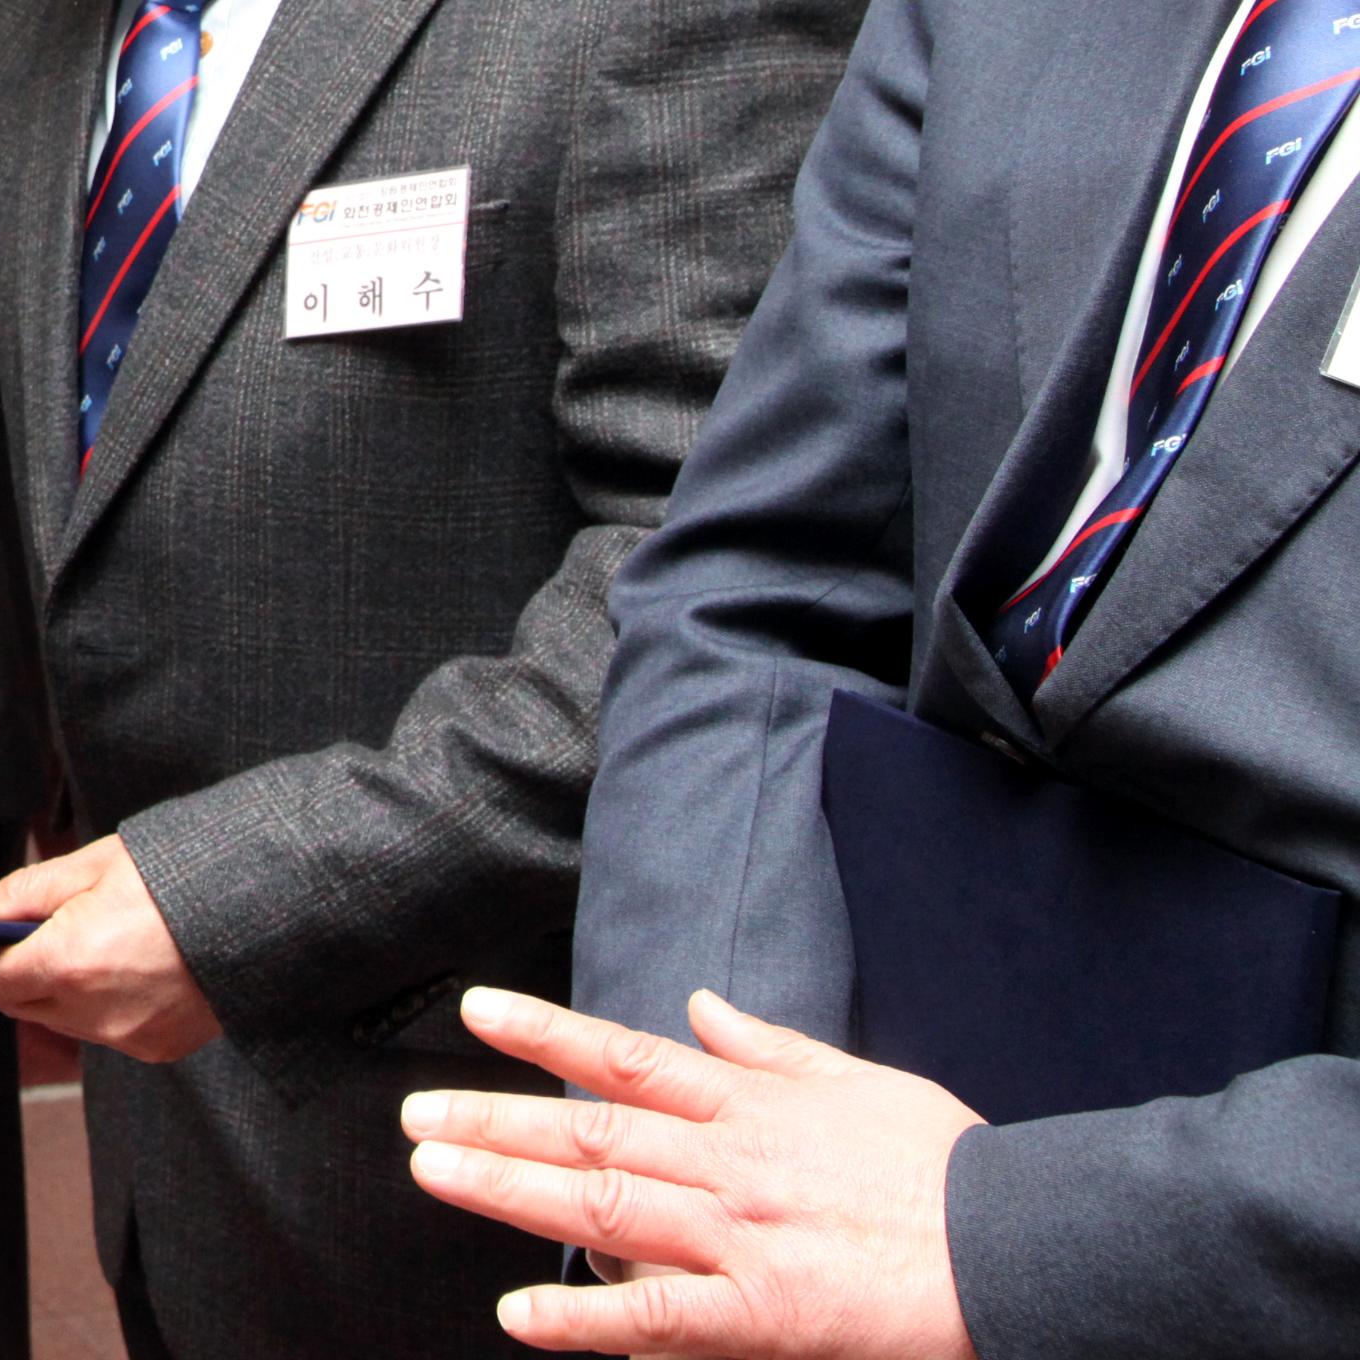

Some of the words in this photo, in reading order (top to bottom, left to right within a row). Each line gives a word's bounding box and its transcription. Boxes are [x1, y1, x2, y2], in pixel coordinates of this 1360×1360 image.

[1333, 13, 1360, 35] FG
[1240, 46, 1271, 76] FGI
[1265, 137, 1302, 165] FGI
[296, 200, 338, 226] FGI
[343, 192, 458, 220] 화천경제인연합회
[1215, 279, 1244, 311] FGI
